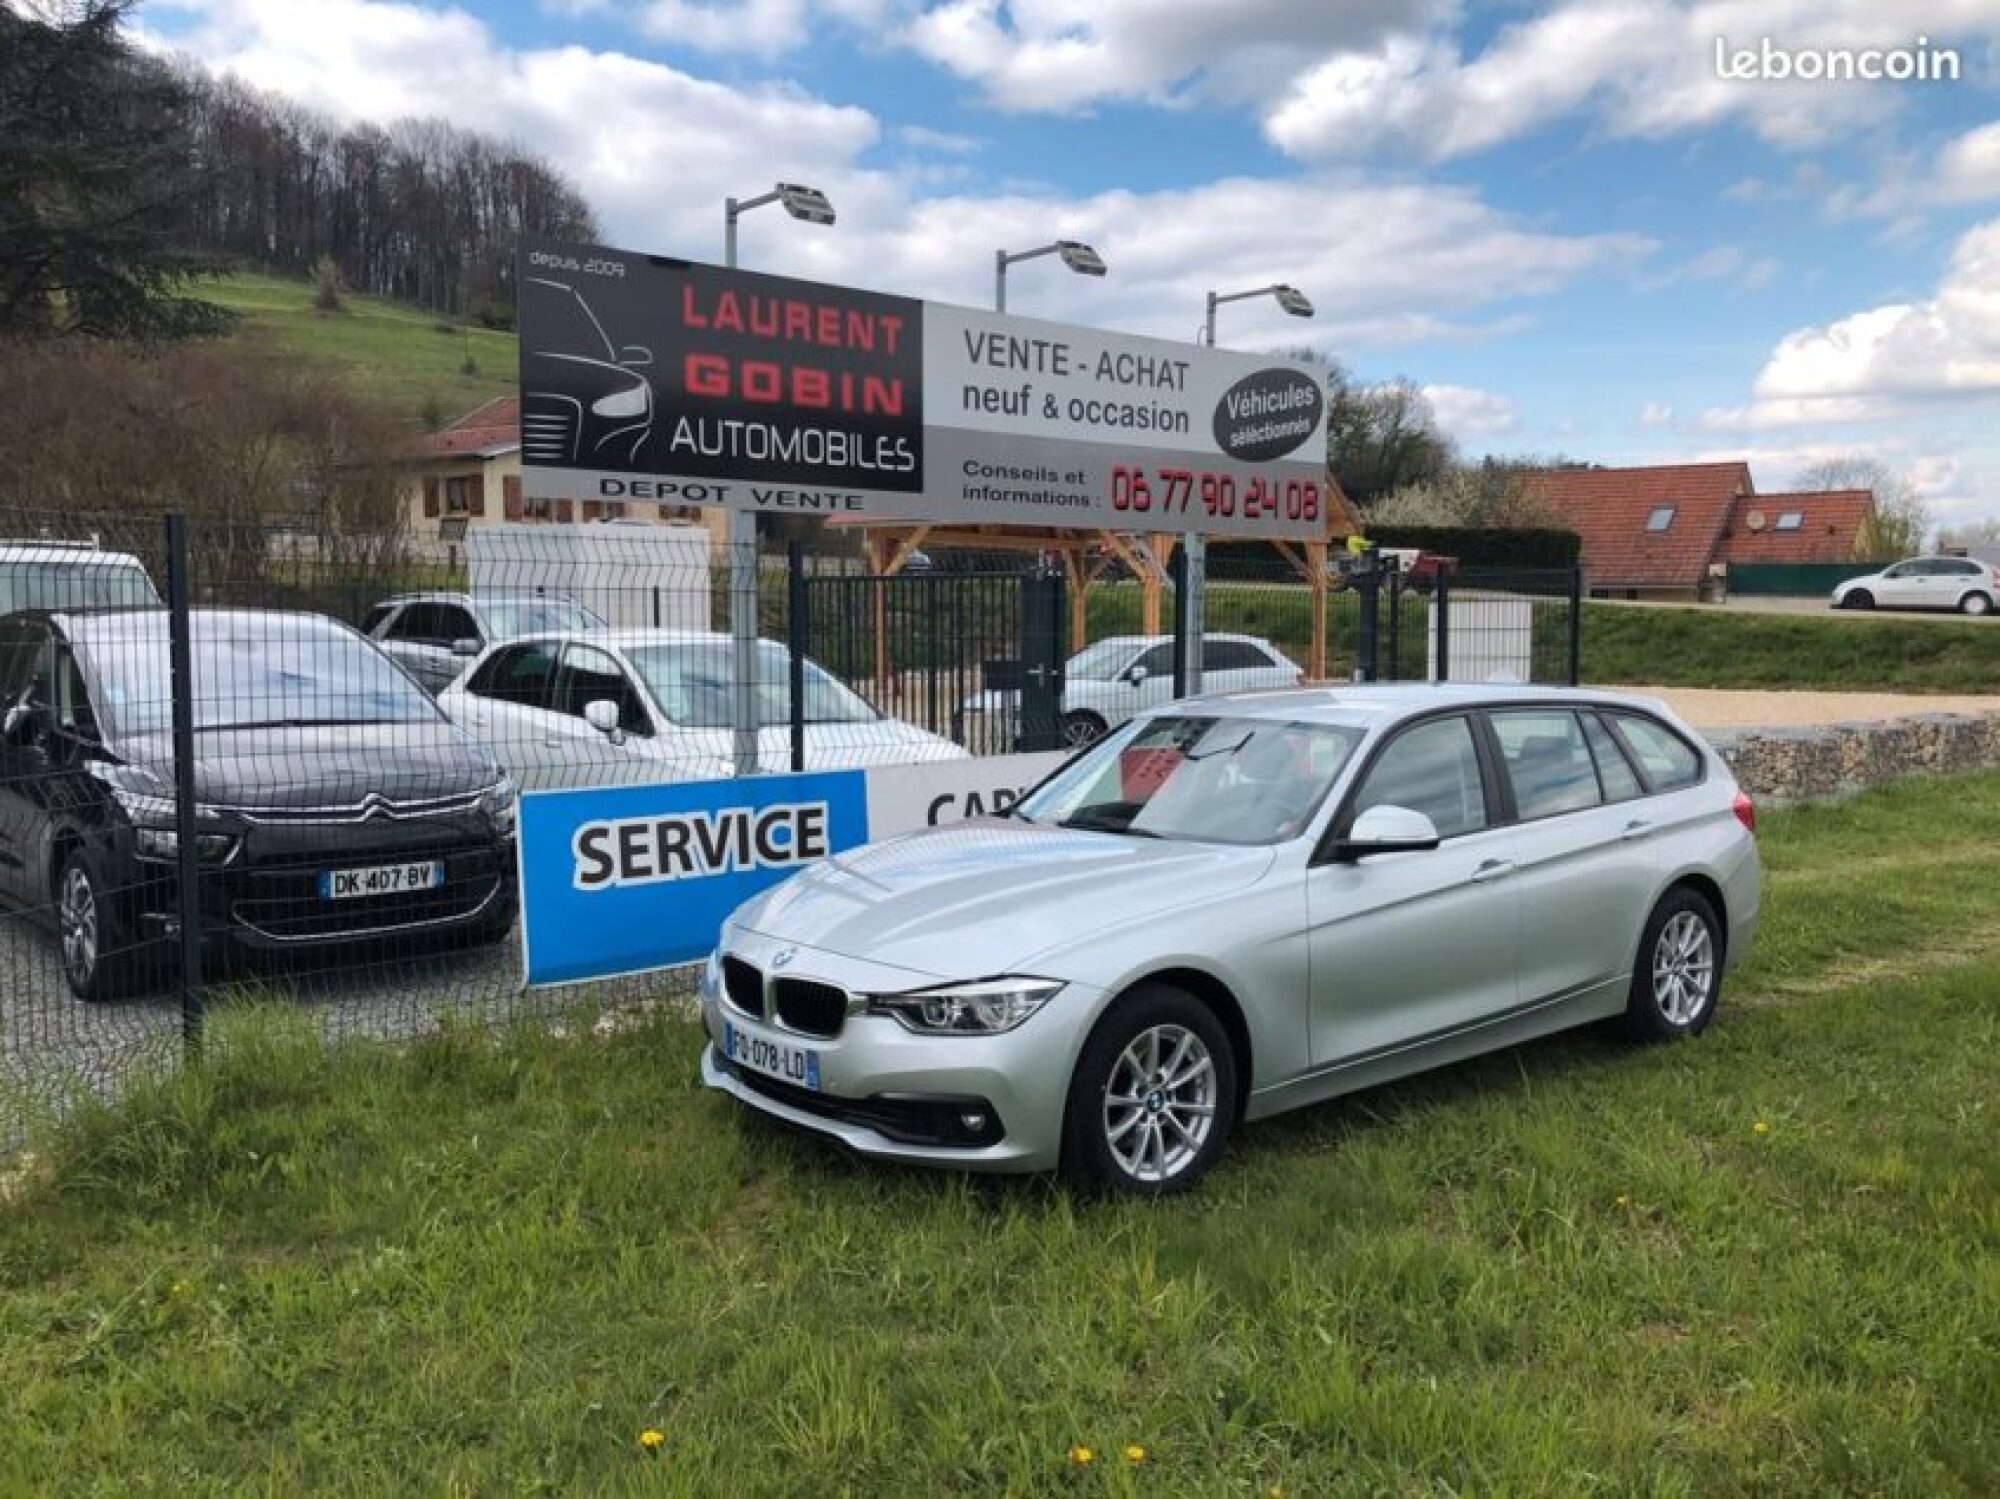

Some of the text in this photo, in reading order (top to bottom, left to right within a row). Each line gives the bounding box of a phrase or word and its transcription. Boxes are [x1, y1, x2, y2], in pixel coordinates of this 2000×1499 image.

[529, 252, 625, 277] depuis 2009
[682, 285, 904, 354] LAURENT
[684, 353, 903, 416] GOBIN
[964, 329, 1069, 376] VENTE
[1096, 349, 1190, 392] ACHAT
[963, 384, 1189, 433] neuf & occasion
[1227, 382, 1314, 420] Véhicules
[670, 415, 915, 472] AUTOMOBILES
[601, 478, 865, 511] DEPOT VENTE
[963, 460, 1084, 484] Conseils et
[963, 484, 1089, 506] informations
[1113, 464, 1318, 520] 06 77 90 24 08
[576, 807, 825, 885] SERVICE
